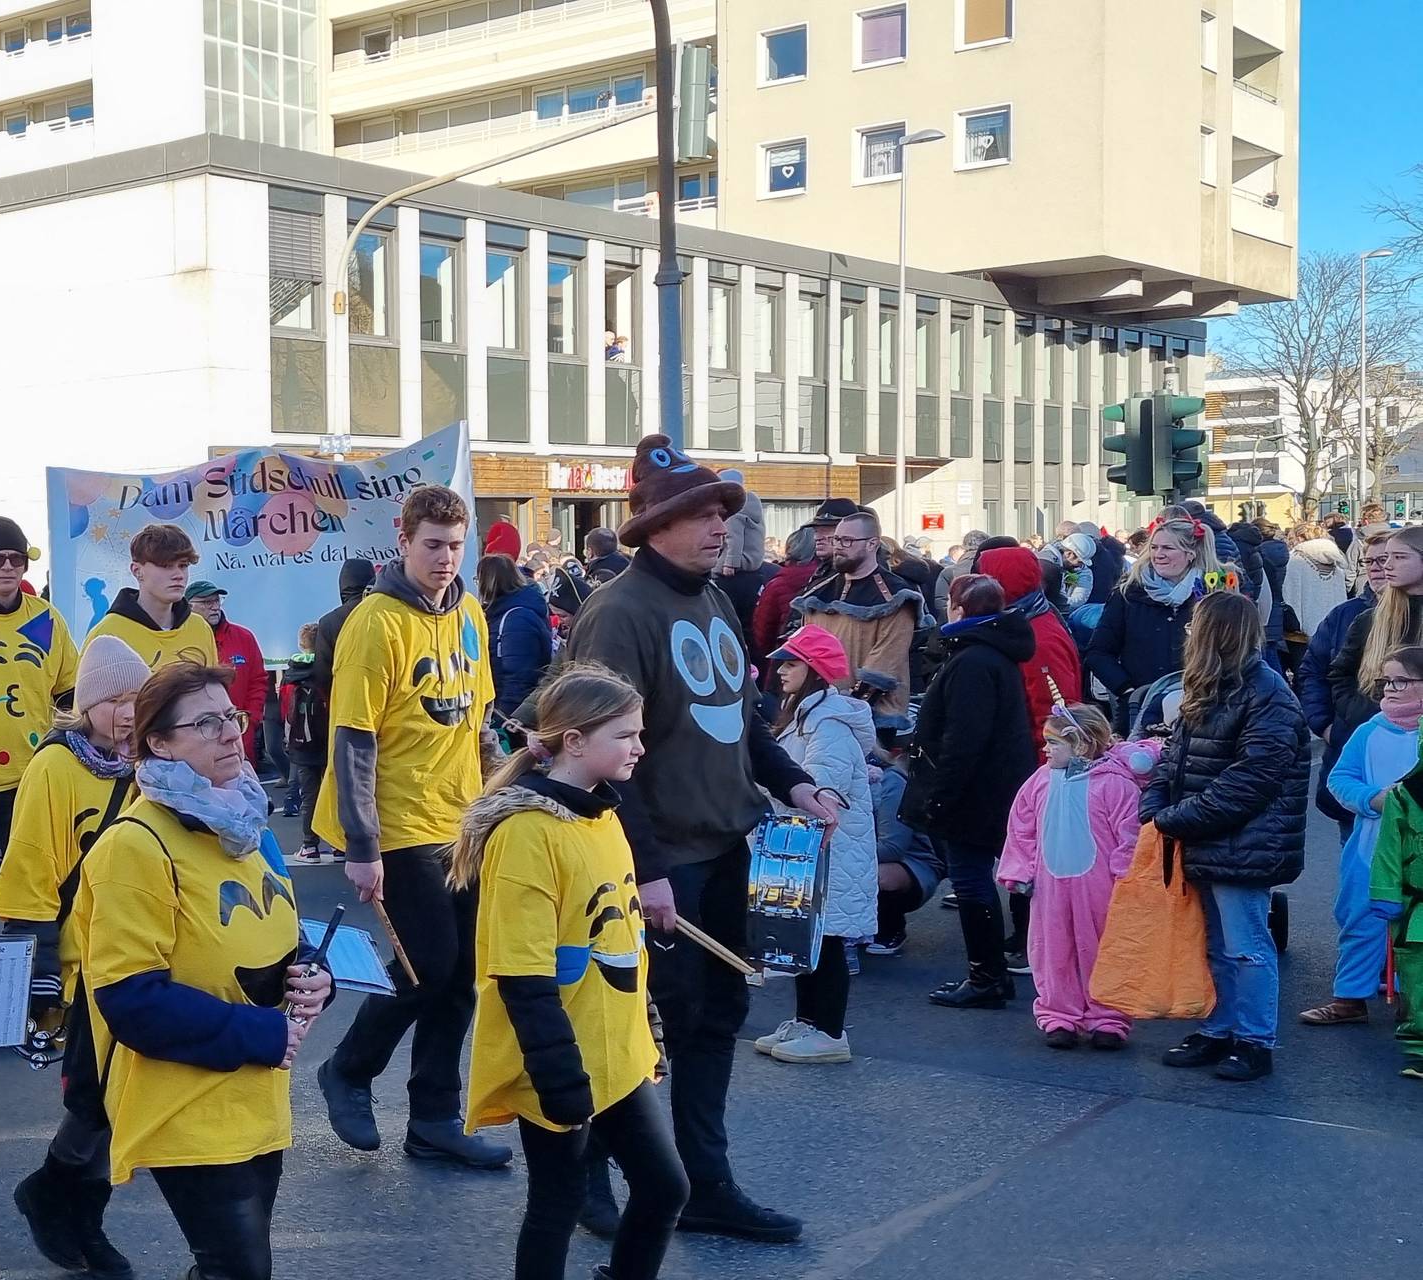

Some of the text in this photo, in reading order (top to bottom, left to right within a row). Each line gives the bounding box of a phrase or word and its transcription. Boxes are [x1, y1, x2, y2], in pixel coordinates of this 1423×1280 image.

[119, 478, 194, 510] Dam
[204, 461, 348, 500] Südschull
[203, 502, 346, 542] Märchen
[252, 550, 285, 567] wat
[293, 550, 314, 564] es
[321, 544, 348, 562] dat
